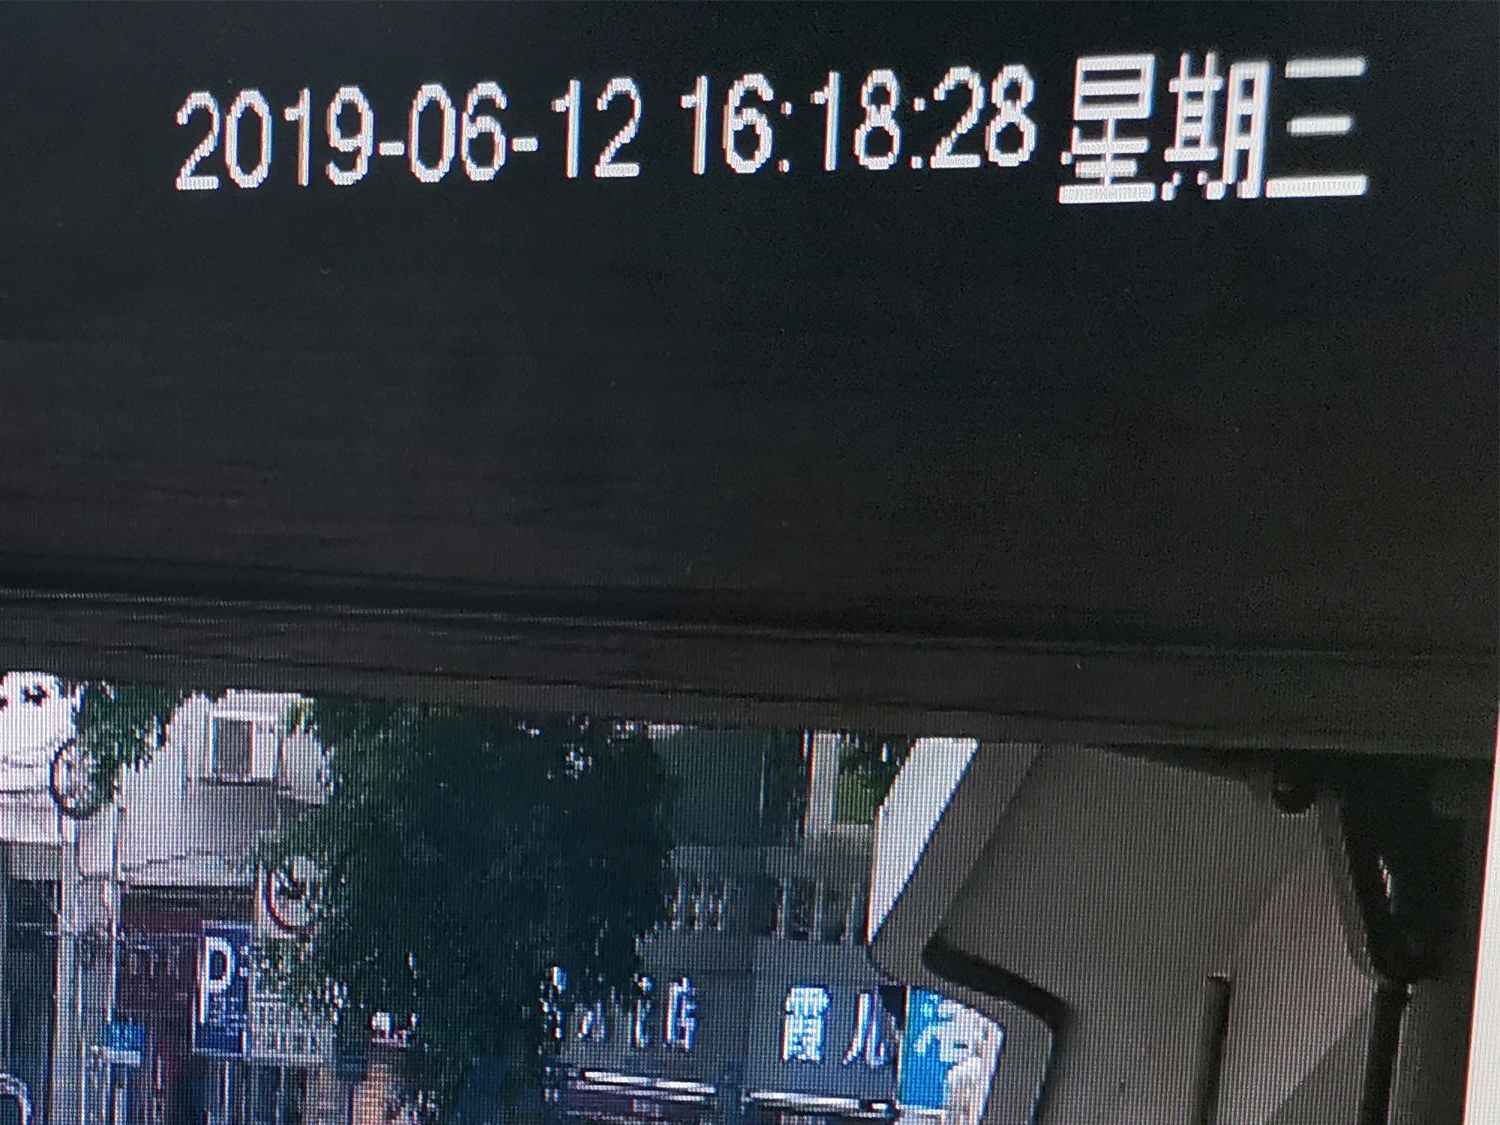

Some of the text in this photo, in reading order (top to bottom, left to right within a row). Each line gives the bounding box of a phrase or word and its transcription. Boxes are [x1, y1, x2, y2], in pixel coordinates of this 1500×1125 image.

[174, 50, 1370, 206] 2019-06-12 16:18:28 星期三
